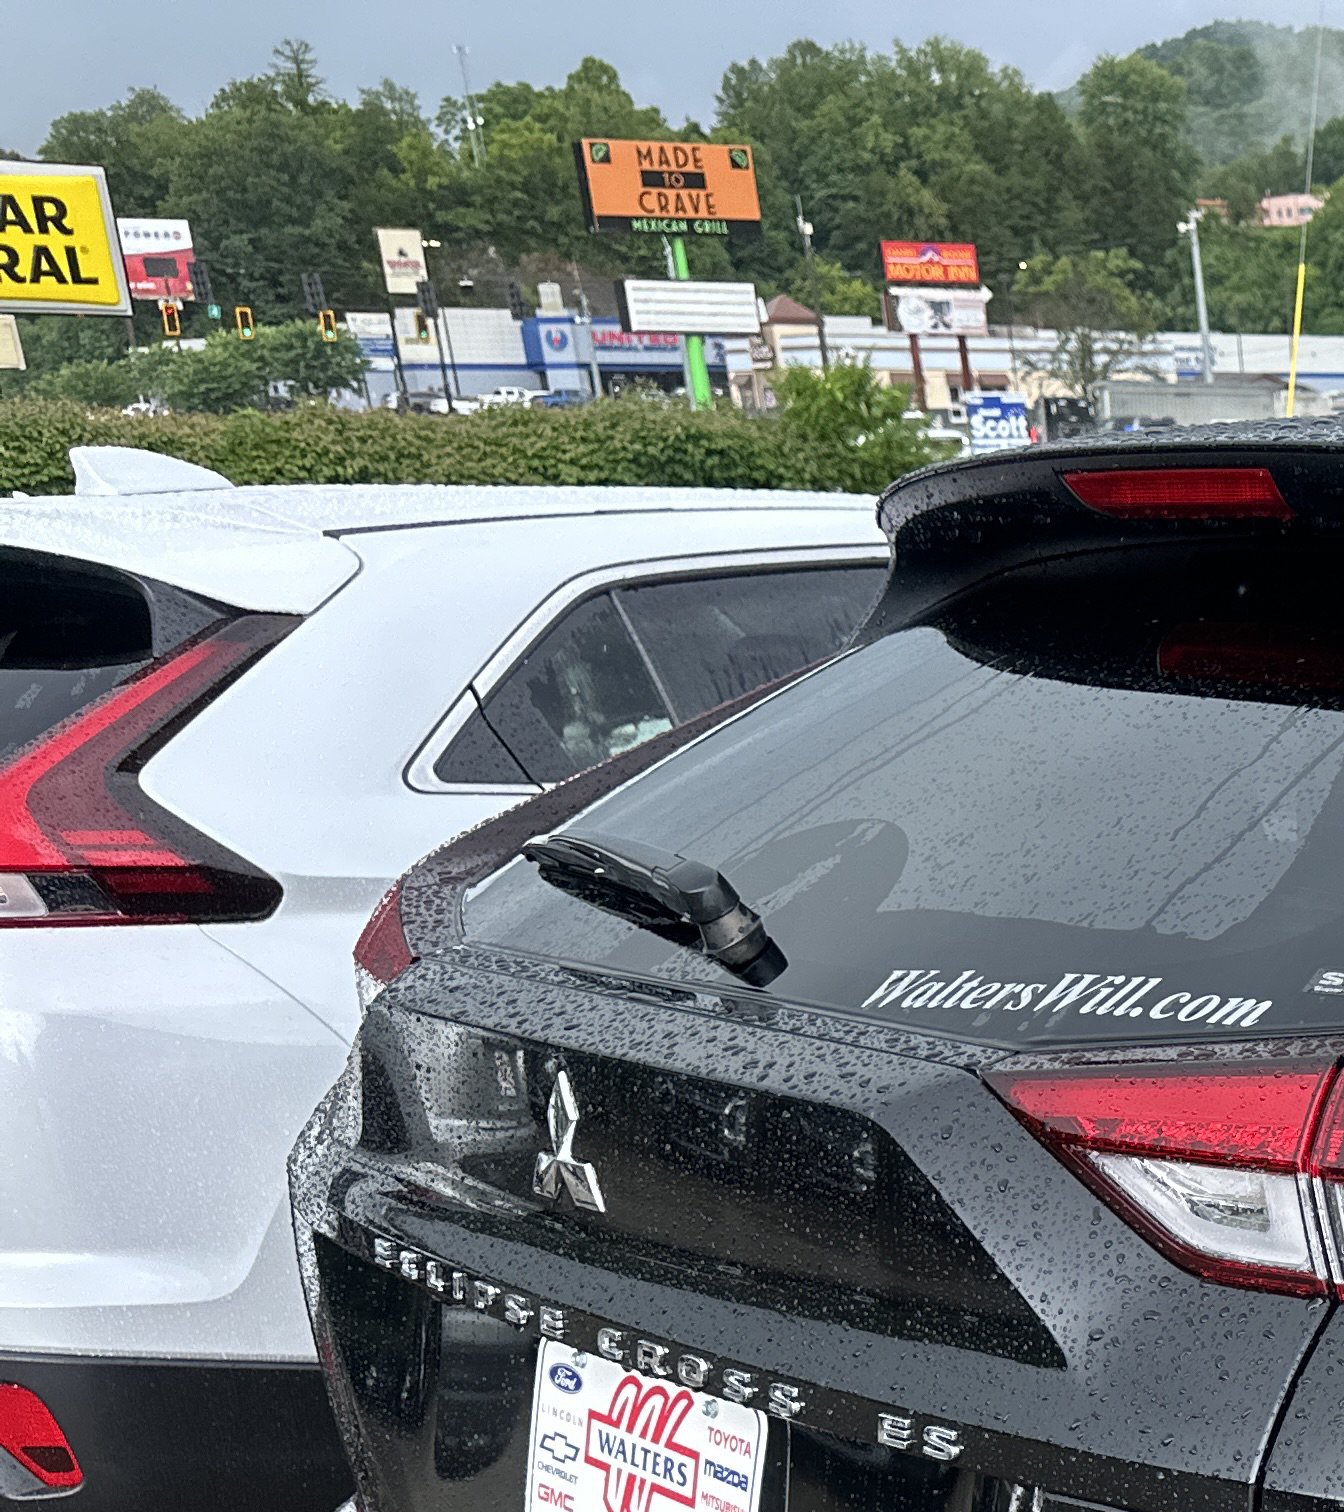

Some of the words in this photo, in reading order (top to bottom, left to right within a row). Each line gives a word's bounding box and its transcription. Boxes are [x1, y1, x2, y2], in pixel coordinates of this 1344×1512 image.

[635, 145, 705, 170] MADE
[638, 191, 717, 216] CRAVE
[630, 218, 689, 233] MEXICAN
[692, 220, 729, 235] GRILL
[887, 262, 944, 280] MOTOR
[591, 330, 680, 347] UNITED
[970, 414, 1029, 438] Scott
[861, 969, 1273, 1028] WaltersWill.com
[374, 1238, 567, 1339] ECLIPSE
[596, 1327, 804, 1418] CROSS
[877, 1413, 964, 1460] ES
[554, 1367, 578, 1391] Ford
[541, 1403, 584, 1427] LINCOLN
[707, 1426, 752, 1459] TOYOTA
[598, 1429, 688, 1488] WALTERS
[537, 1461, 579, 1485] CHEVROLET
[538, 1483, 575, 1512] GMC
